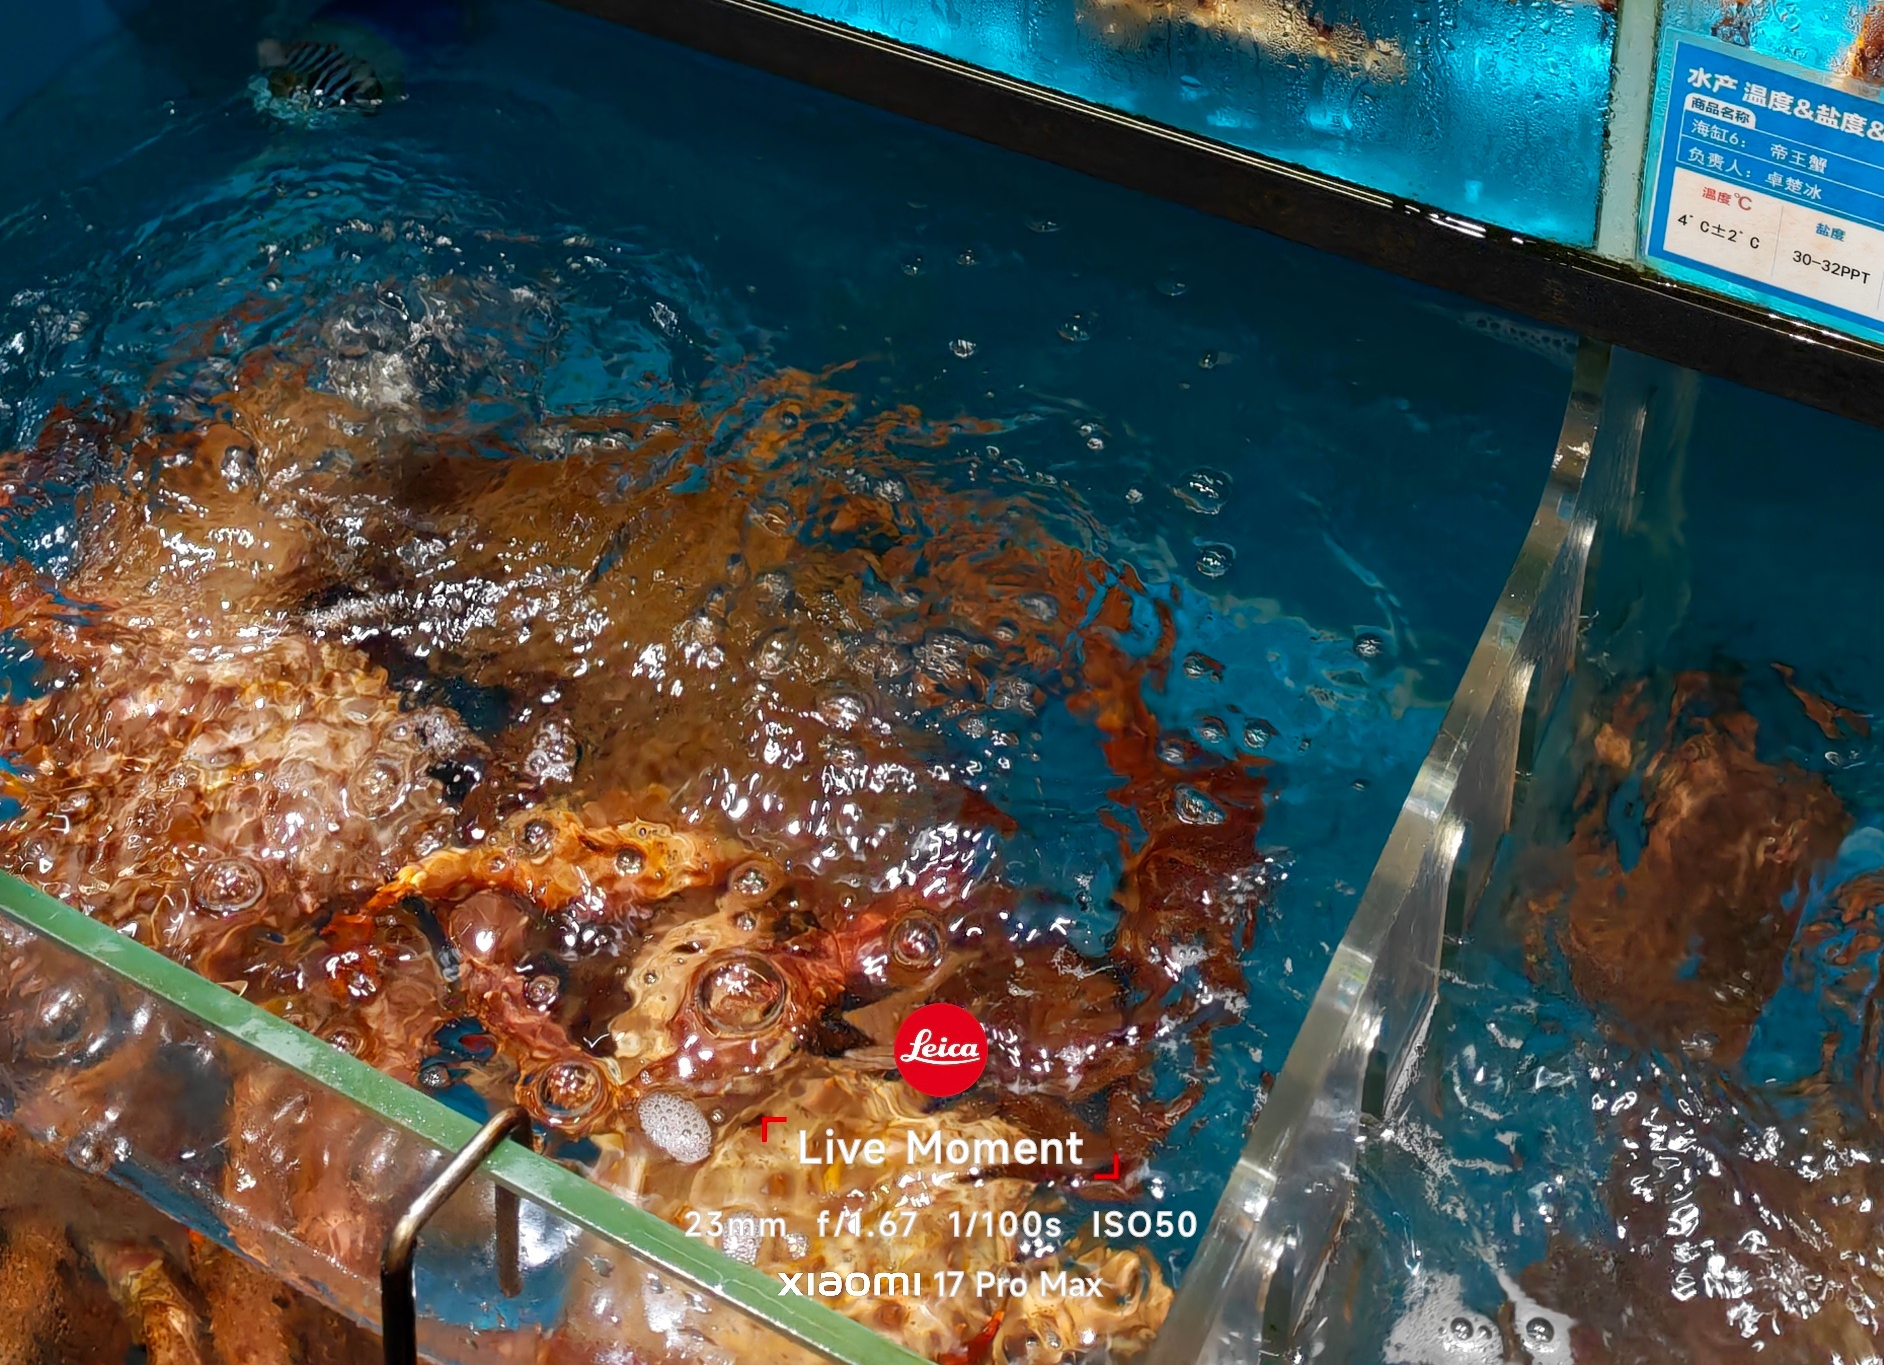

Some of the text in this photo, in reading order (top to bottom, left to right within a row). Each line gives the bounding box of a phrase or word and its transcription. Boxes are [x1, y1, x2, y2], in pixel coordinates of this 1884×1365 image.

[1687, 67, 1738, 93] 水产
[1691, 97, 1750, 125] 商品名称
[1770, 144, 1828, 174] 帝王蟹
[1764, 171, 1823, 200] 卓楚冰
[1815, 222, 1846, 242] 盐度
[1792, 250, 1871, 285] 30-32PPT
